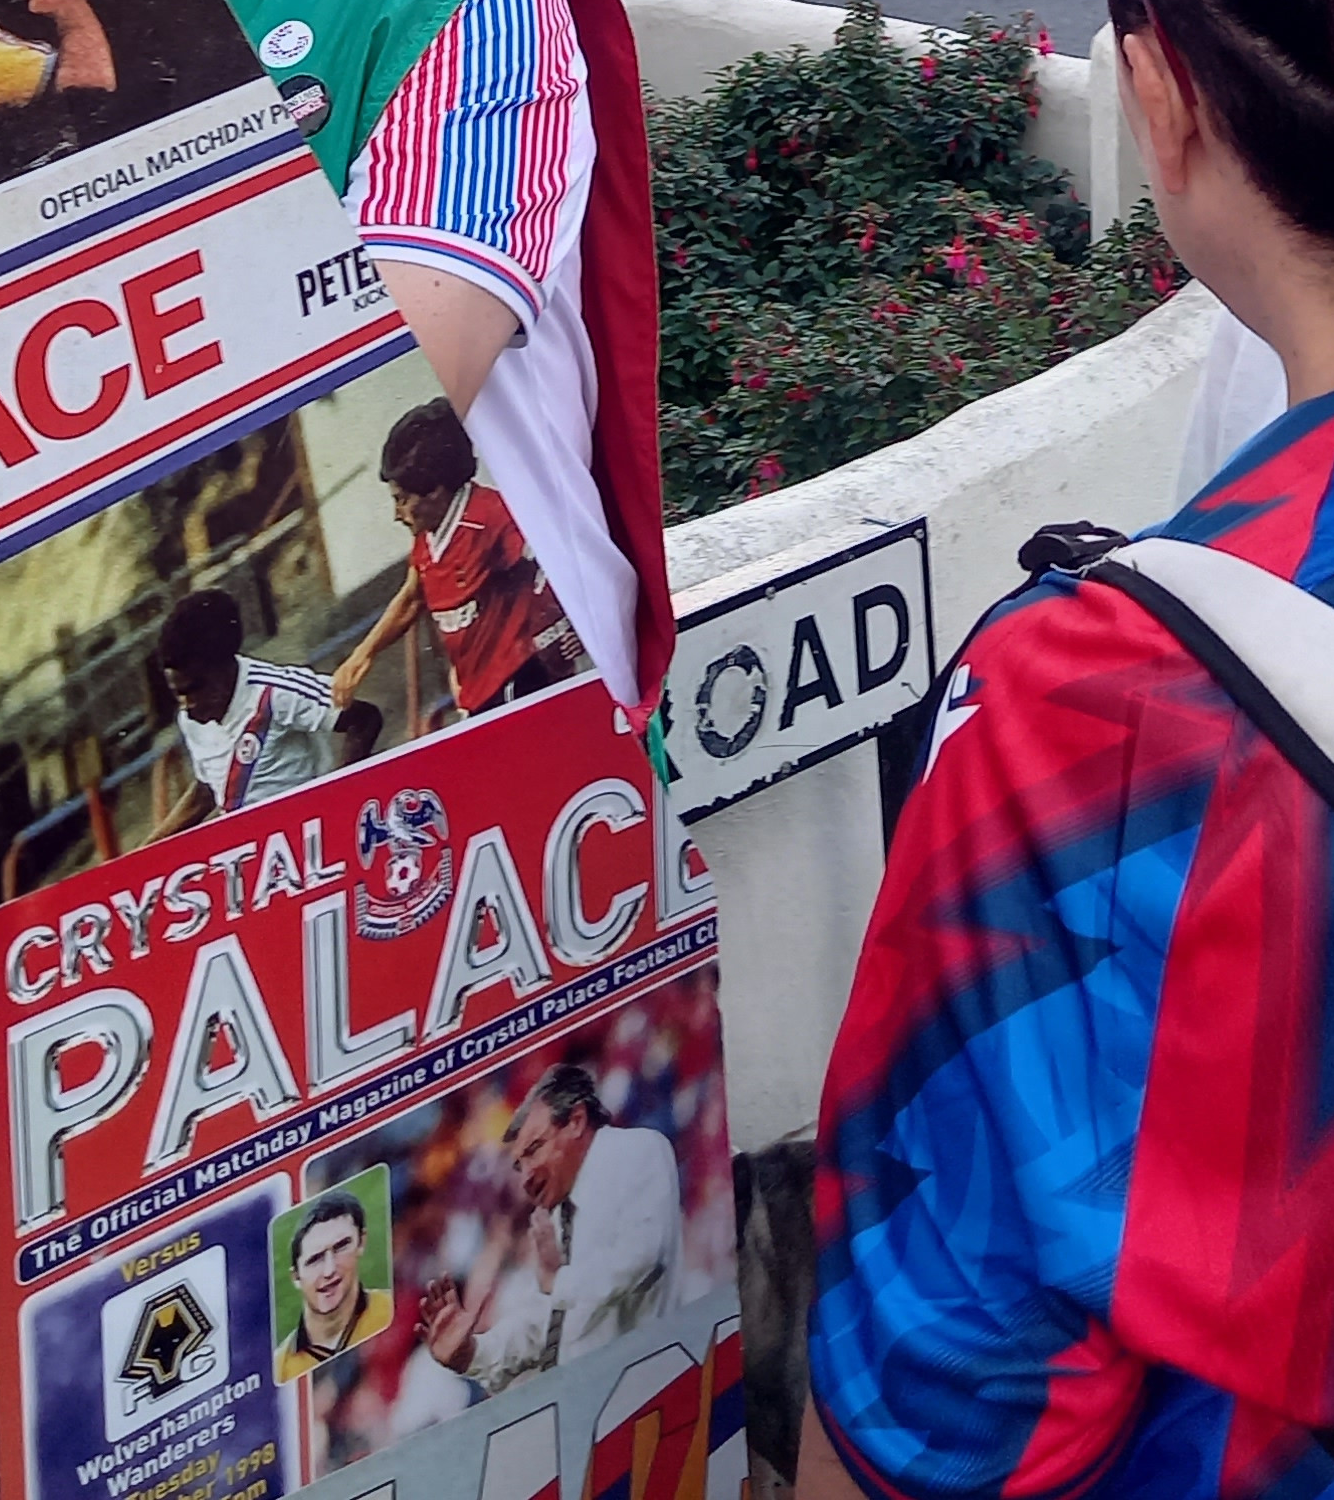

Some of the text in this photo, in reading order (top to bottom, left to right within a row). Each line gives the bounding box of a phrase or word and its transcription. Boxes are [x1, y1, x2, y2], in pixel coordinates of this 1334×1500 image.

[40, 163, 144, 220] OFFICIAL
[146, 112, 268, 177] MATCHDAY
[295, 244, 381, 317] PETE
[6, 818, 347, 1005] CRYSTAL
[29, 921, 719, 1269] The Official Matchday Magazine of Crystal Palace Football Cl
[120, 1231, 202, 1284] Versus
[75, 1372, 262, 1486] Wolverhampton
[106, 1412, 236, 1498] Wanderers
[225, 1442, 276, 1487] 1998
